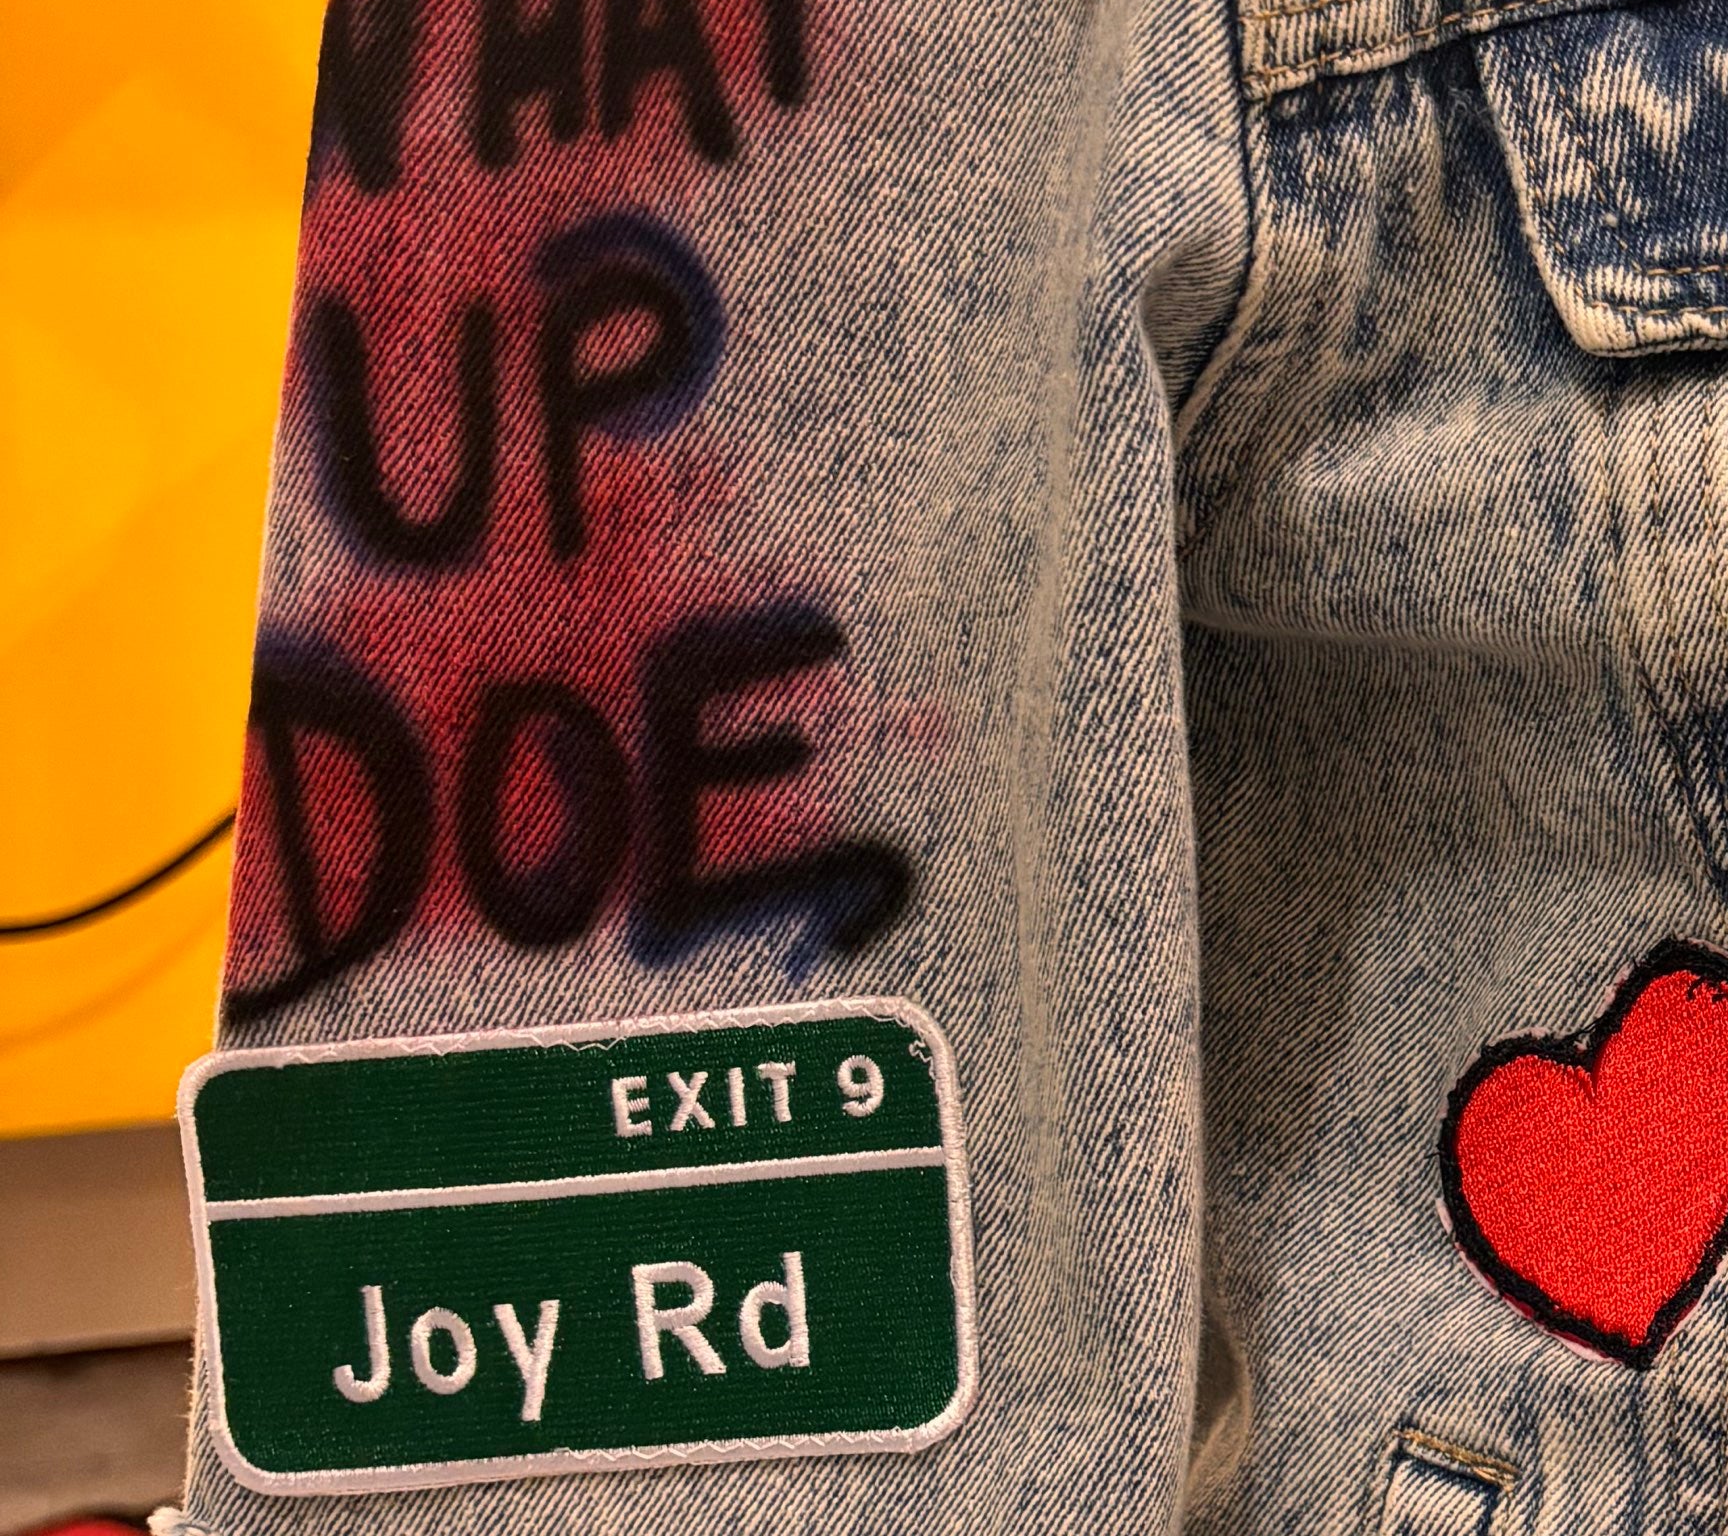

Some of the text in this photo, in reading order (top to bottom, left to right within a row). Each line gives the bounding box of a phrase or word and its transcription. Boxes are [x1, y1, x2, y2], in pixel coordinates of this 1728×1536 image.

[308, 214, 726, 566] UP
[222, 596, 916, 1022] DOE
[611, 1054, 885, 1139] EXIT 9
[332, 1250, 811, 1423] Joy Rd
